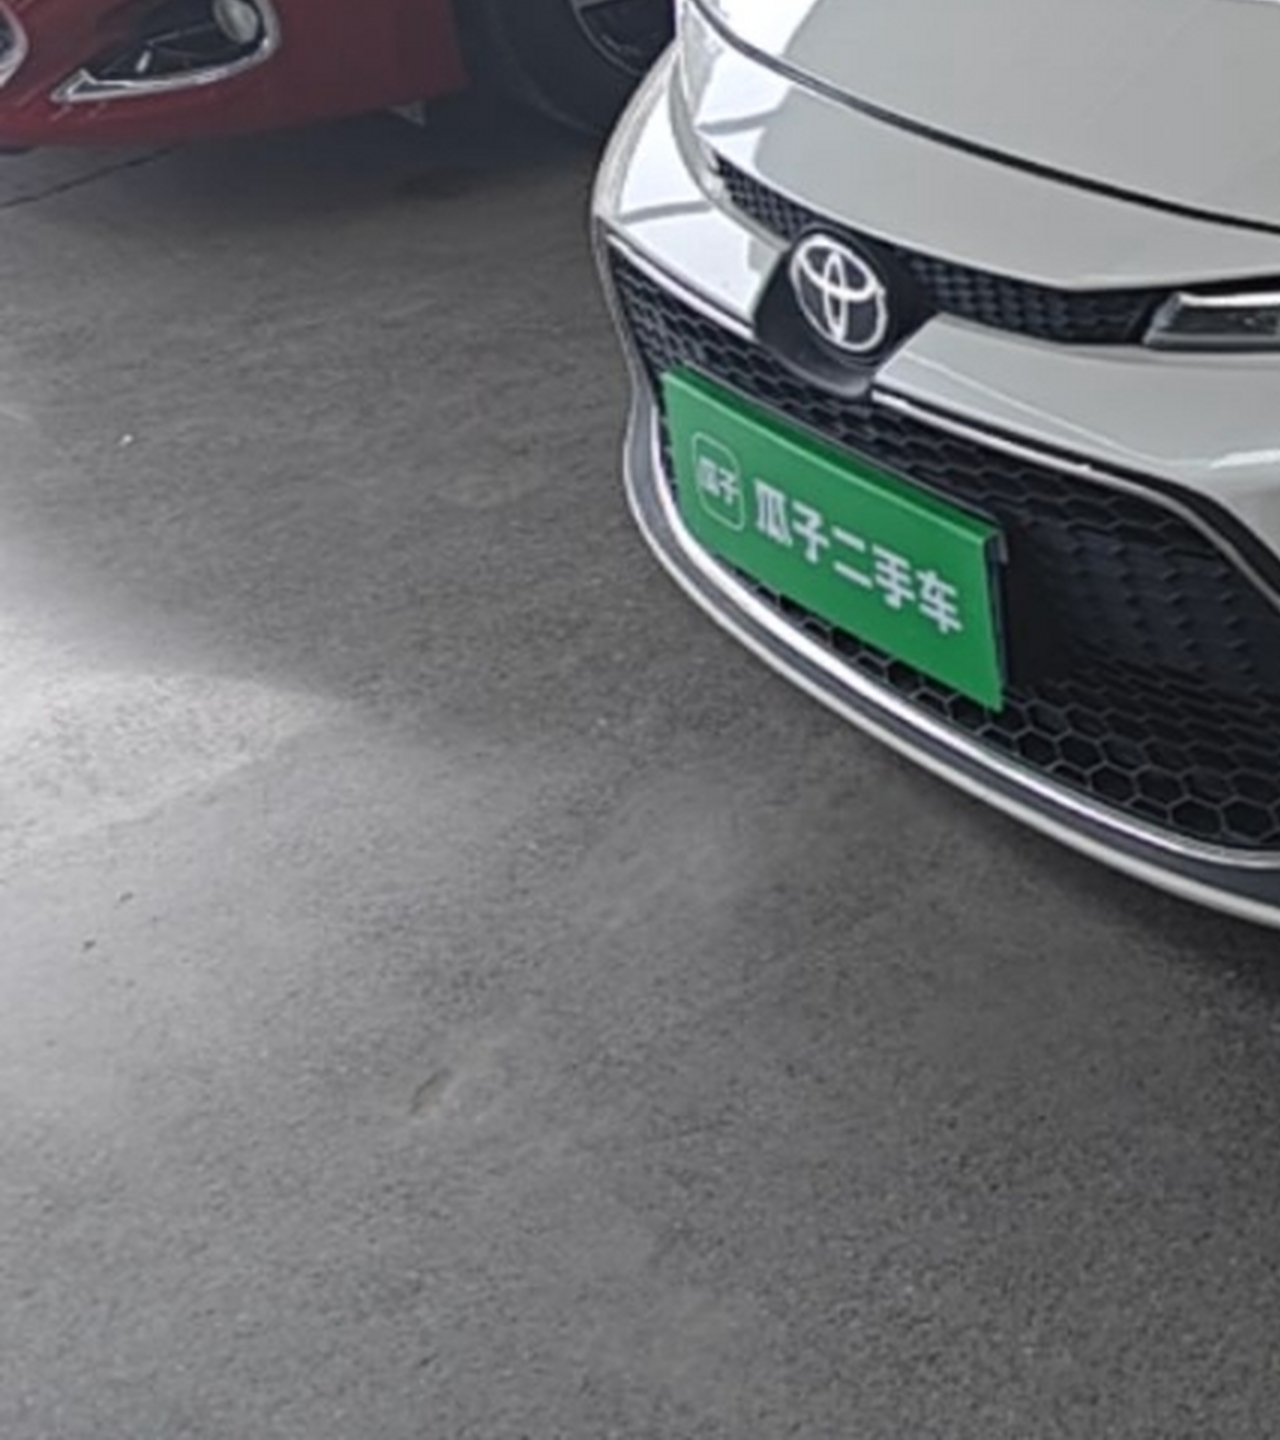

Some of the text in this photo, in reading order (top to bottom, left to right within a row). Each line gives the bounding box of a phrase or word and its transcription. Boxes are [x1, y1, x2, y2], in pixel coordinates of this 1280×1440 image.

[698, 456, 740, 506] 瓜子
[754, 478, 962, 633] 瓜子二手车
